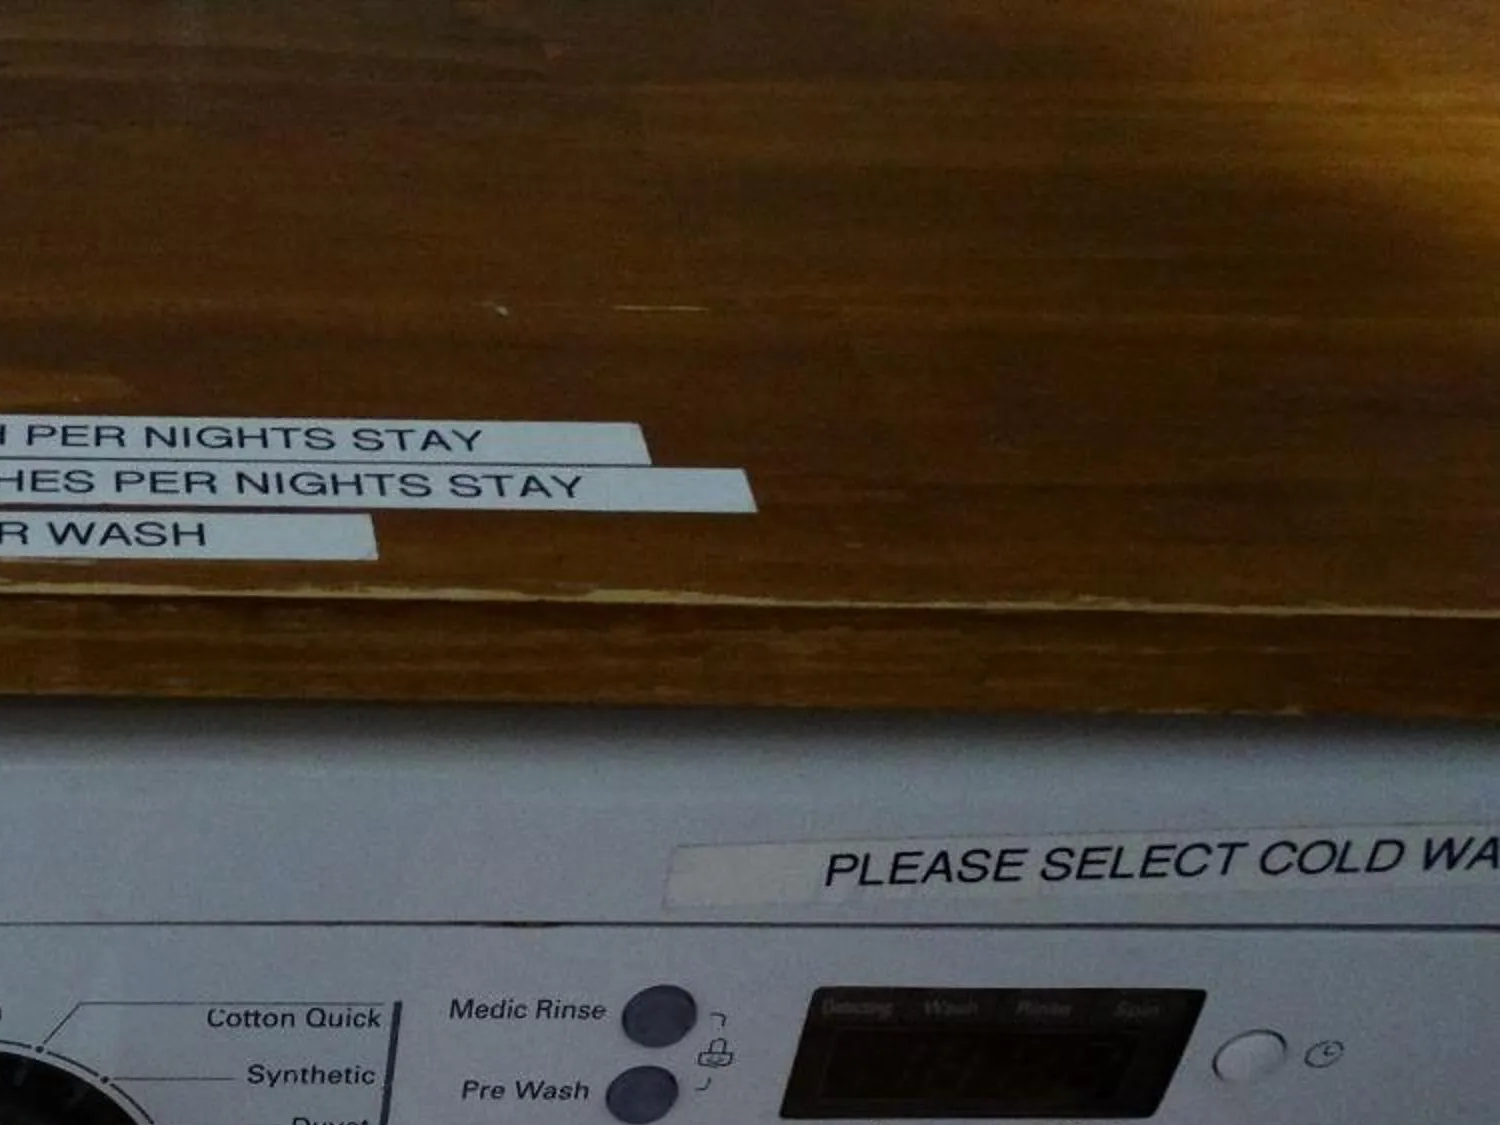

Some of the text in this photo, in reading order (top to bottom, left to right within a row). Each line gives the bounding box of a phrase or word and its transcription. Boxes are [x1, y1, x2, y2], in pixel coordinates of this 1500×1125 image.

[26, 424, 125, 448] PER
[144, 426, 336, 451] NIGHTS
[352, 428, 482, 452] STAY
[114, 470, 217, 495] PER
[236, 471, 432, 498] NIGHTS
[448, 473, 582, 499] STAY
[47, 521, 206, 547] WASH
[825, 848, 1029, 887] PLEASE
[1040, 841, 1250, 882] SELECT
[1259, 838, 1406, 877] COLD
[207, 1007, 381, 1029] Cotton Quick
[449, 998, 607, 1021] Medic Rinse
[247, 1063, 376, 1088] Synthetic
[461, 1079, 589, 1101] Pre Wash
